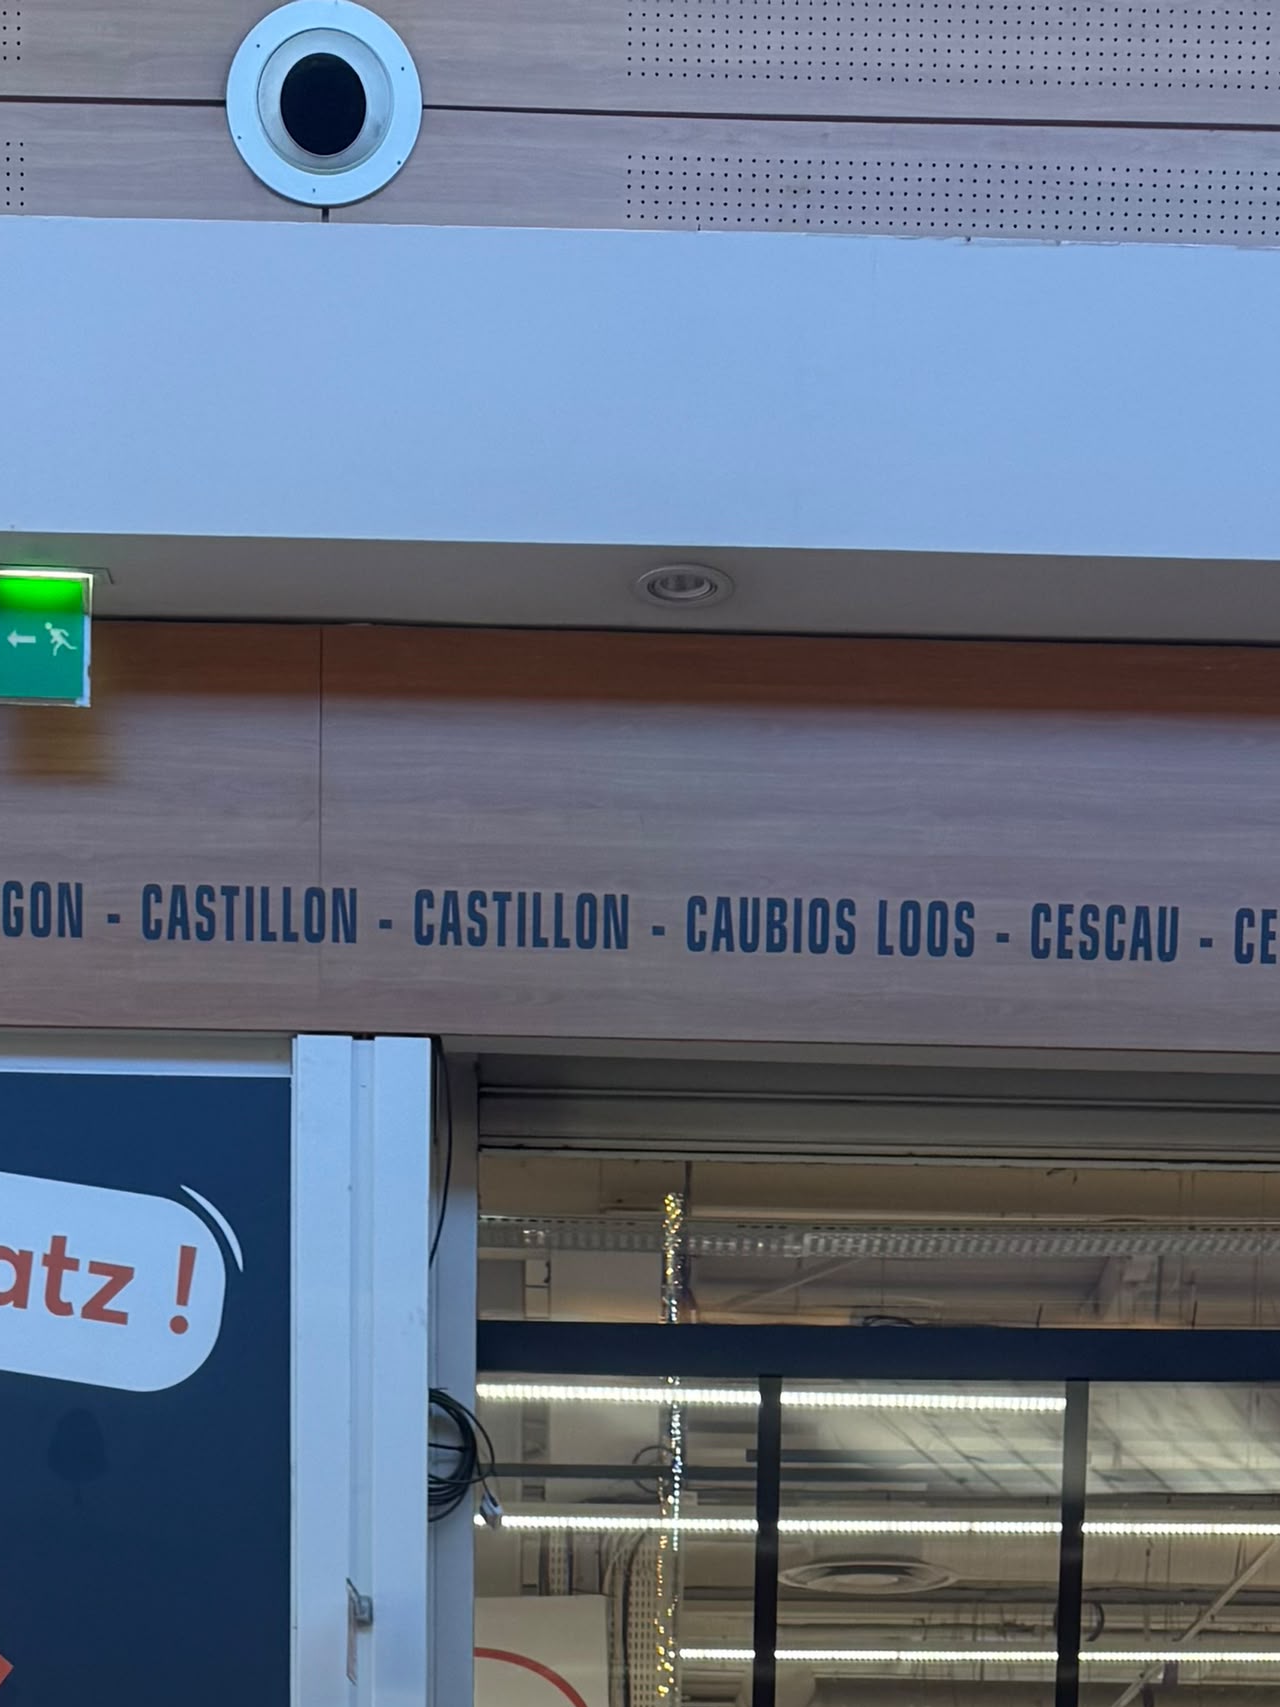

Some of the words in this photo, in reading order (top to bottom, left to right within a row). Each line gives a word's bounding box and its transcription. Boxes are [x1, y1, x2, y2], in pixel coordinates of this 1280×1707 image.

[141, 883, 358, 944] CASTILLON
[413, 889, 629, 950] CASTILLON
[686, 895, 856, 955] CAUBIOS
[876, 900, 976, 958] LOOS
[1030, 903, 1179, 963] CESCAU
